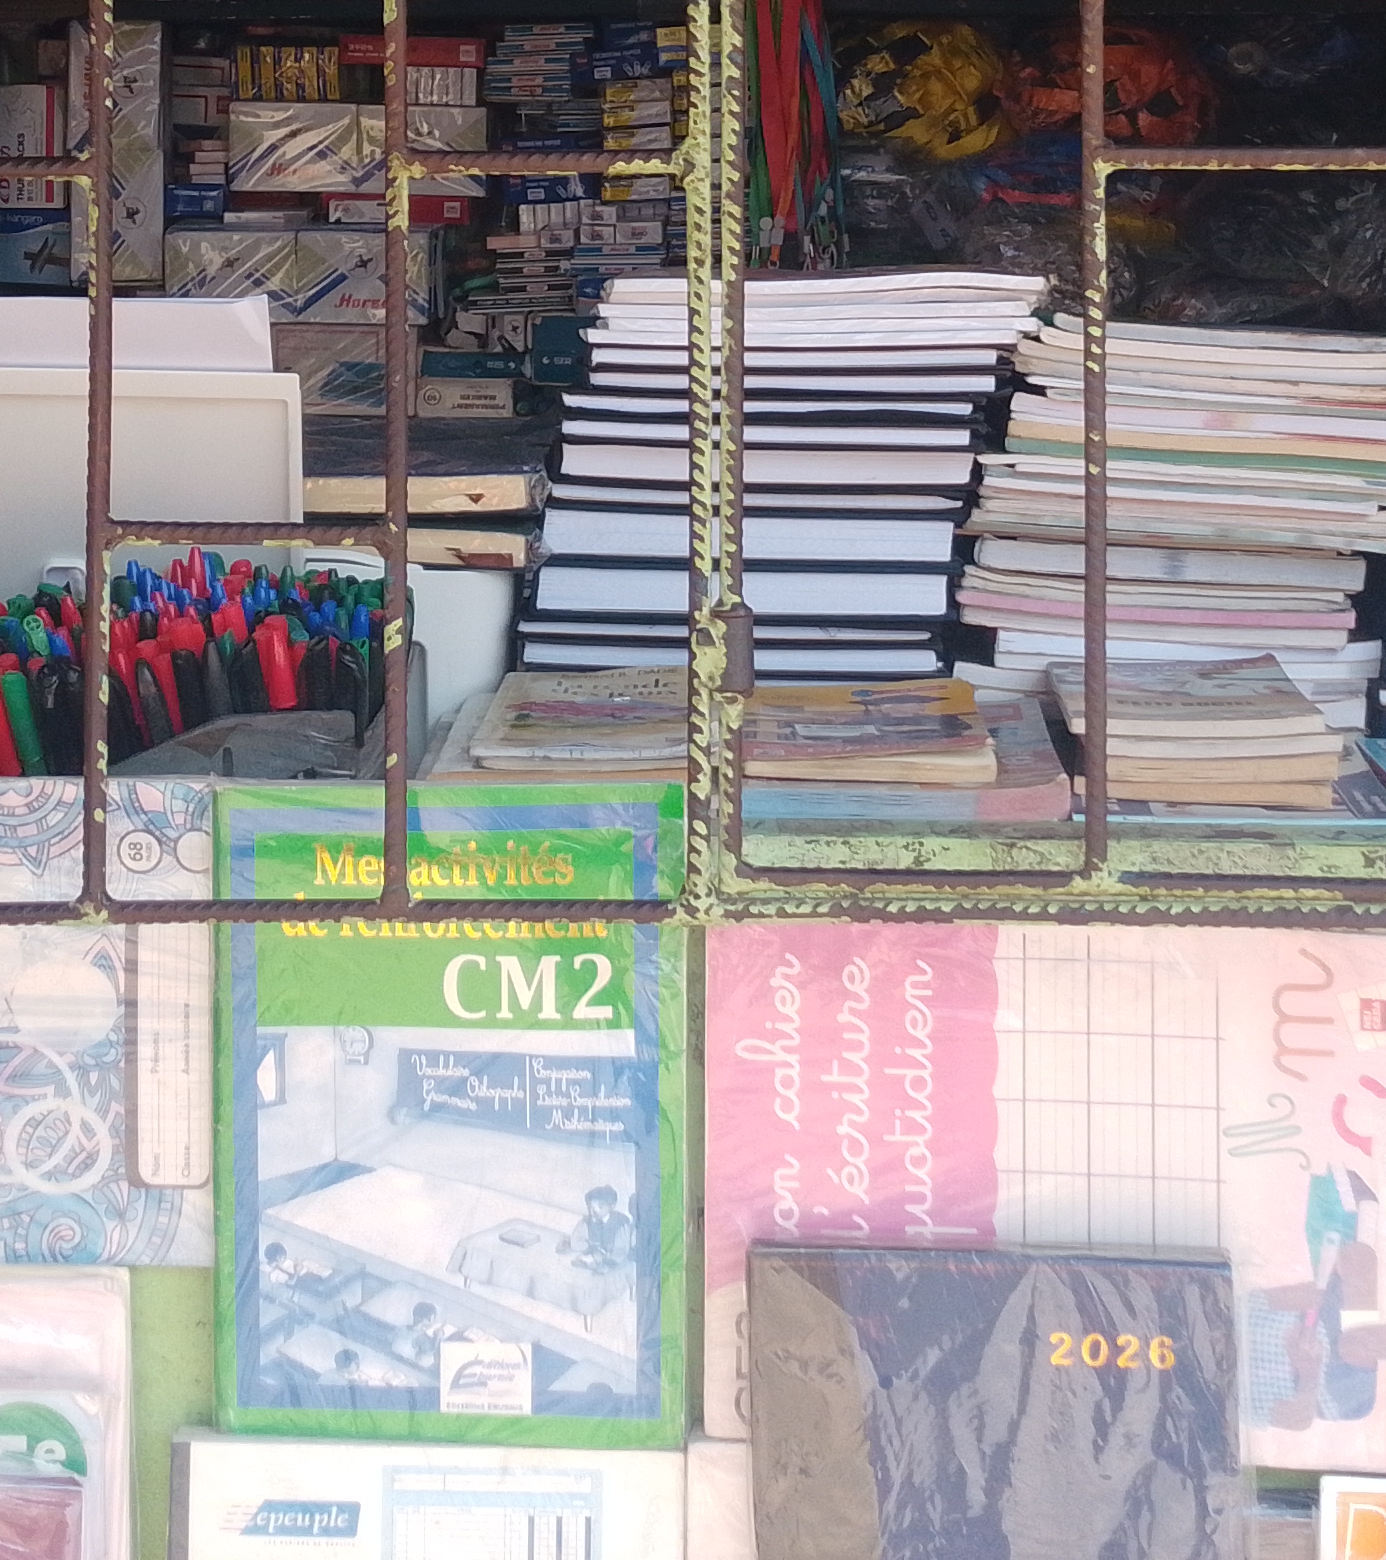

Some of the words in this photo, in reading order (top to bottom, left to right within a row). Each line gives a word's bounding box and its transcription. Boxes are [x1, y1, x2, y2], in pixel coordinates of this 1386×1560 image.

[127, 842, 145, 862] 68
[409, 841, 575, 888] activités
[441, 952, 614, 1021] CM2
[735, 951, 802, 1132] cahier
[1048, 1332, 1176, 1370] 2026
